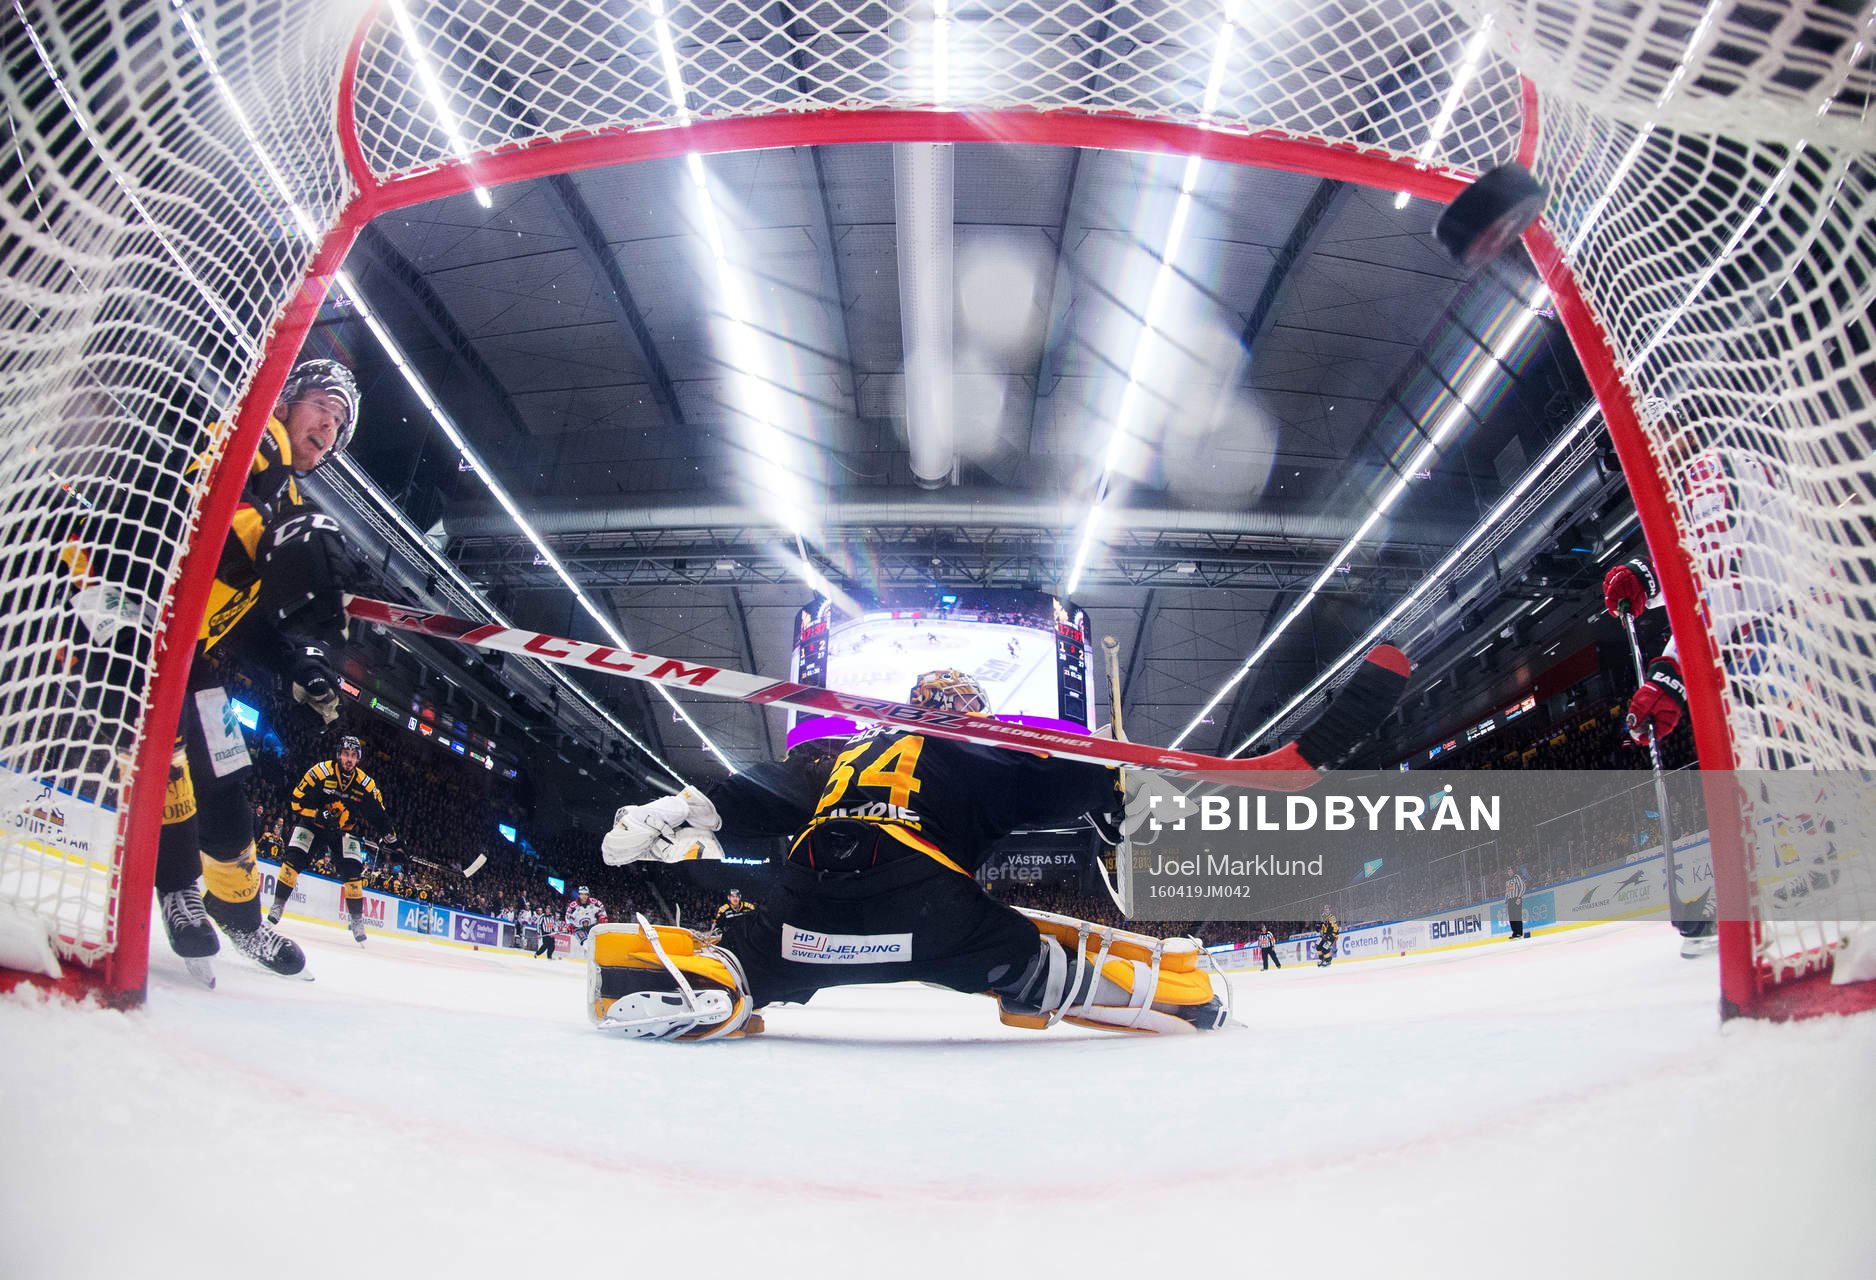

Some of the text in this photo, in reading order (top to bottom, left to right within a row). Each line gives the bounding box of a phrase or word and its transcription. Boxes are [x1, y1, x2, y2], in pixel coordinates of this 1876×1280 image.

[523, 633, 721, 687] CCM
[1652, 671, 1688, 701] EAST
[966, 720, 1094, 748] SPEEDBURNER
[1008, 853, 1076, 865] VÄSTRA STÅ
[340, 886, 386, 921] AXI
[793, 931, 815, 942] HP
[1432, 914, 1482, 940] BOLIDEN
[826, 944, 901, 953] WELDING
[1350, 936, 1379, 949] extena
